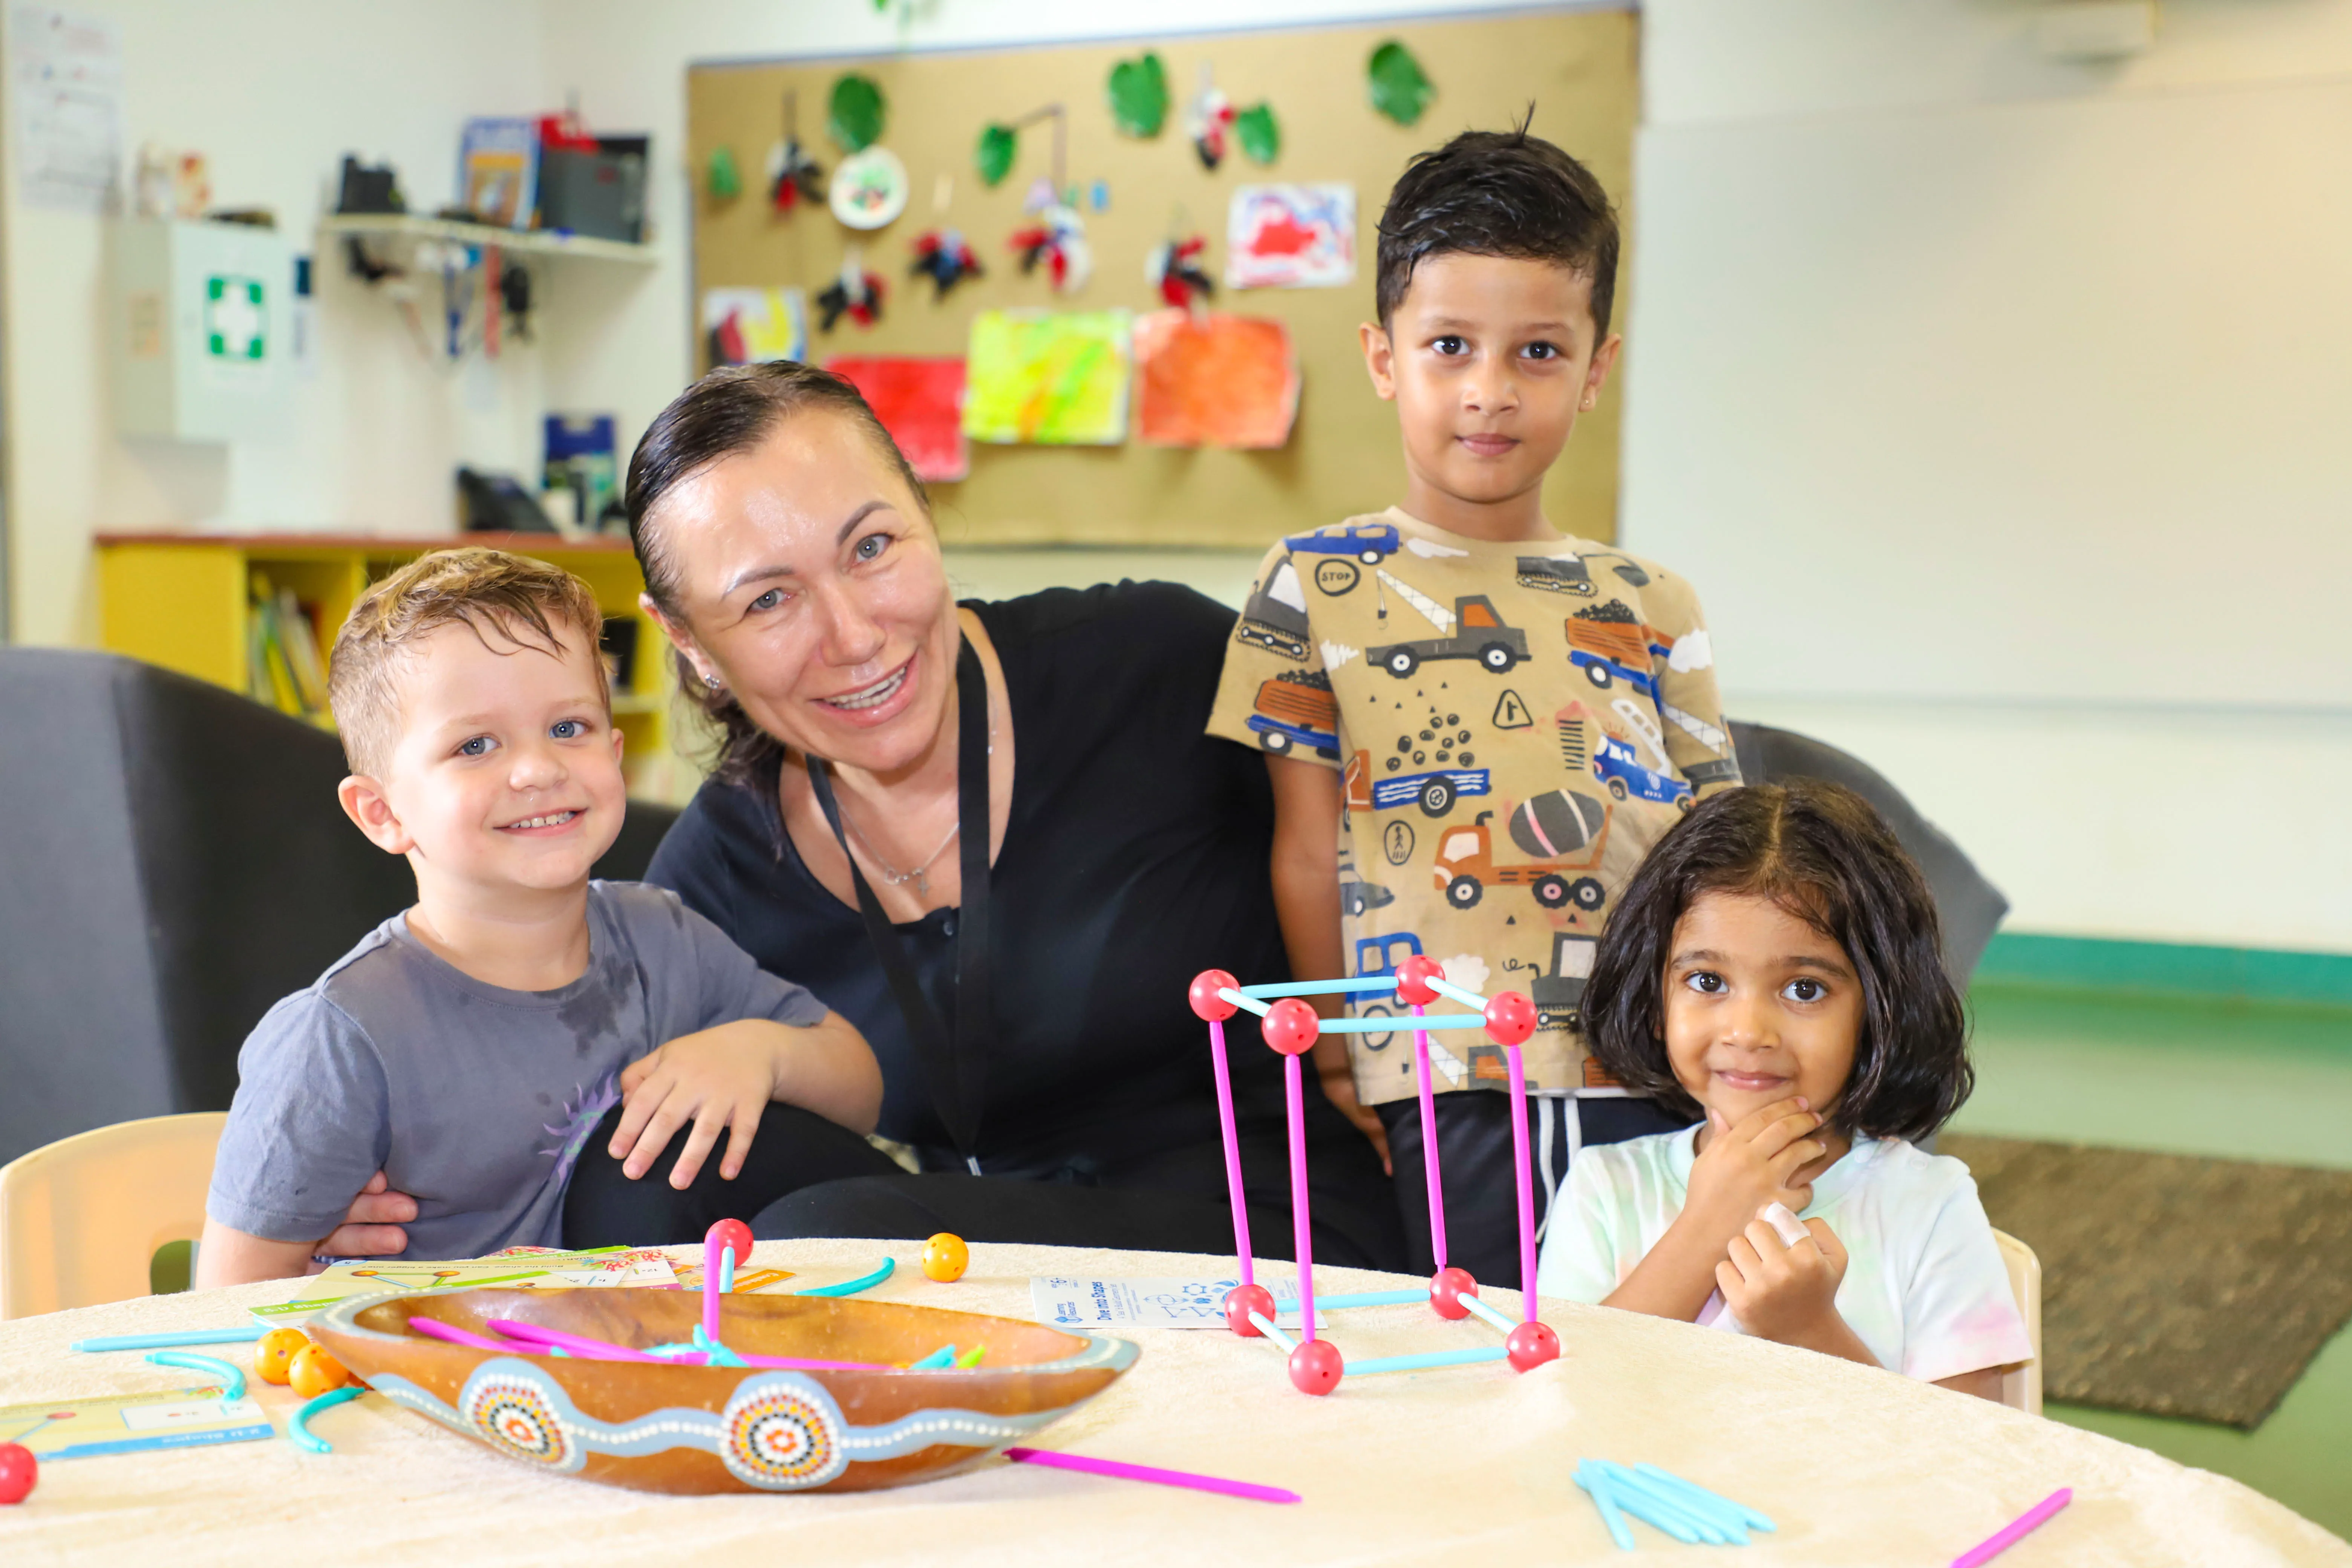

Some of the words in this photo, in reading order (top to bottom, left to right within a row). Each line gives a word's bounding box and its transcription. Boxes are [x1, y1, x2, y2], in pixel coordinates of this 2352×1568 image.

[1322, 572, 1351, 582] STOP
[1091, 1282, 1108, 1297] Shapes
[1094, 1299, 1109, 1308] into
[1096, 1310, 1112, 1320] Dive
